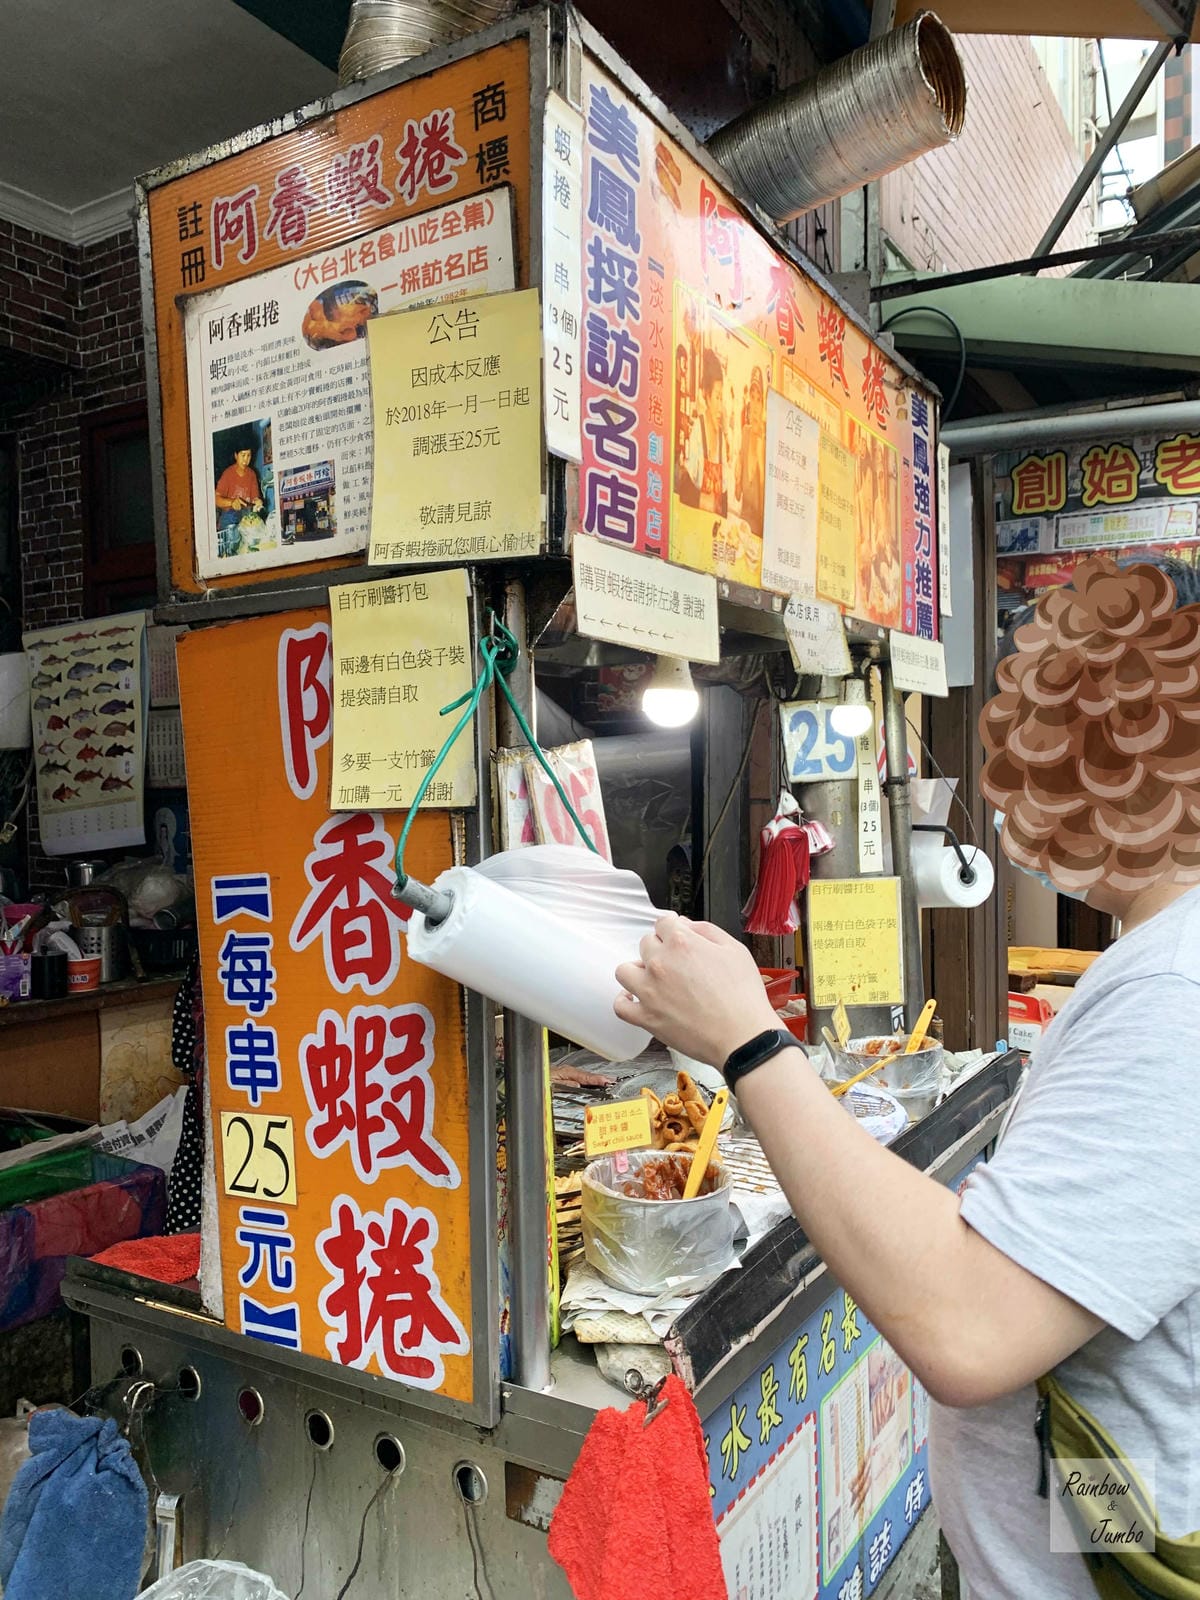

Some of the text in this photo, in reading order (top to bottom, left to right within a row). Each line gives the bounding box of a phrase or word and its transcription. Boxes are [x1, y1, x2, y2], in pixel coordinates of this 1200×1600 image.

[472, 81, 511, 184] 商標
[211, 108, 466, 269] 阿香蝦捲
[178, 201, 206, 288] 註冊
[207, 299, 280, 345] 阿香蝦捲
[585, 82, 642, 549] 美鳳採訪名店
[699, 178, 890, 432] 阿香蝦捲
[426, 308, 480, 346] 公告
[411, 354, 502, 389] 因成本反應
[385, 386, 531, 427] 於2018年一月一日起
[412, 426, 501, 458] 調漲至25元
[420, 500, 493, 527] 敬請見諒
[373, 531, 536, 561] 阿香蝦捲祝您順心愉快
[338, 581, 429, 611] 自行刷醬打包
[579, 563, 706, 621] 購買蝦捲請排左邊 謝謝
[340, 645, 466, 676] 兩邊有白色袋子裝
[340, 684, 419, 708] 提袋請自取
[341, 749, 436, 773] 多要一支竹籤
[338, 784, 403, 804] 加購一元
